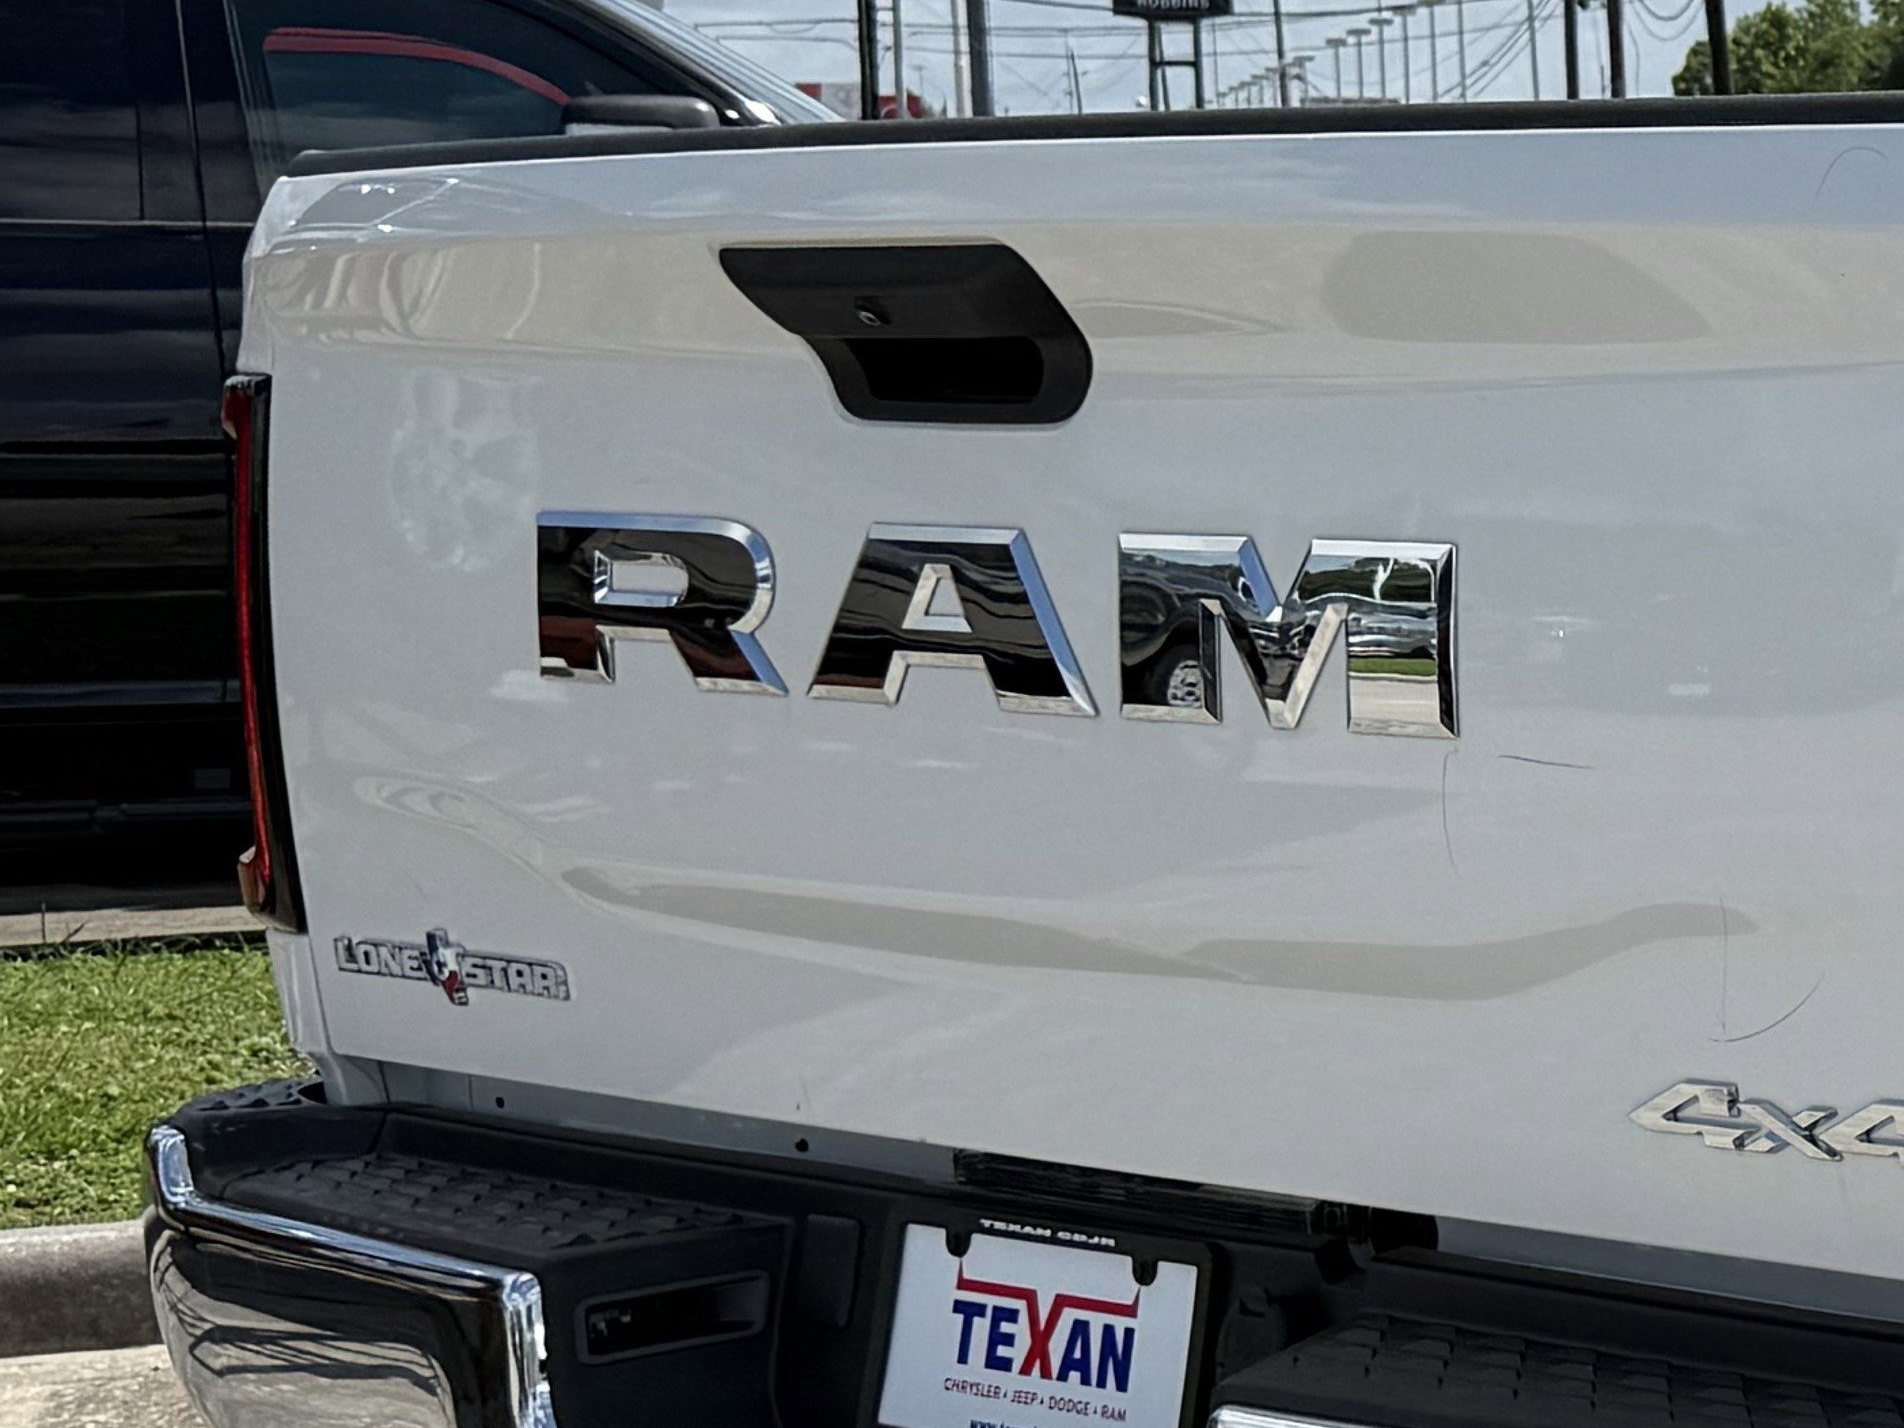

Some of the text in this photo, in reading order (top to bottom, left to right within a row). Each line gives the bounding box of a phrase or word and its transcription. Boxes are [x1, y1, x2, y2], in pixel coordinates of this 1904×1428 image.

[535, 510, 1461, 739] RAM
[334, 936, 570, 1001] LONE STAR
[952, 1286, 1136, 1394] TEXAN
[943, 1376, 1127, 1422] CHRYSLER JEEP DODGE RAM
